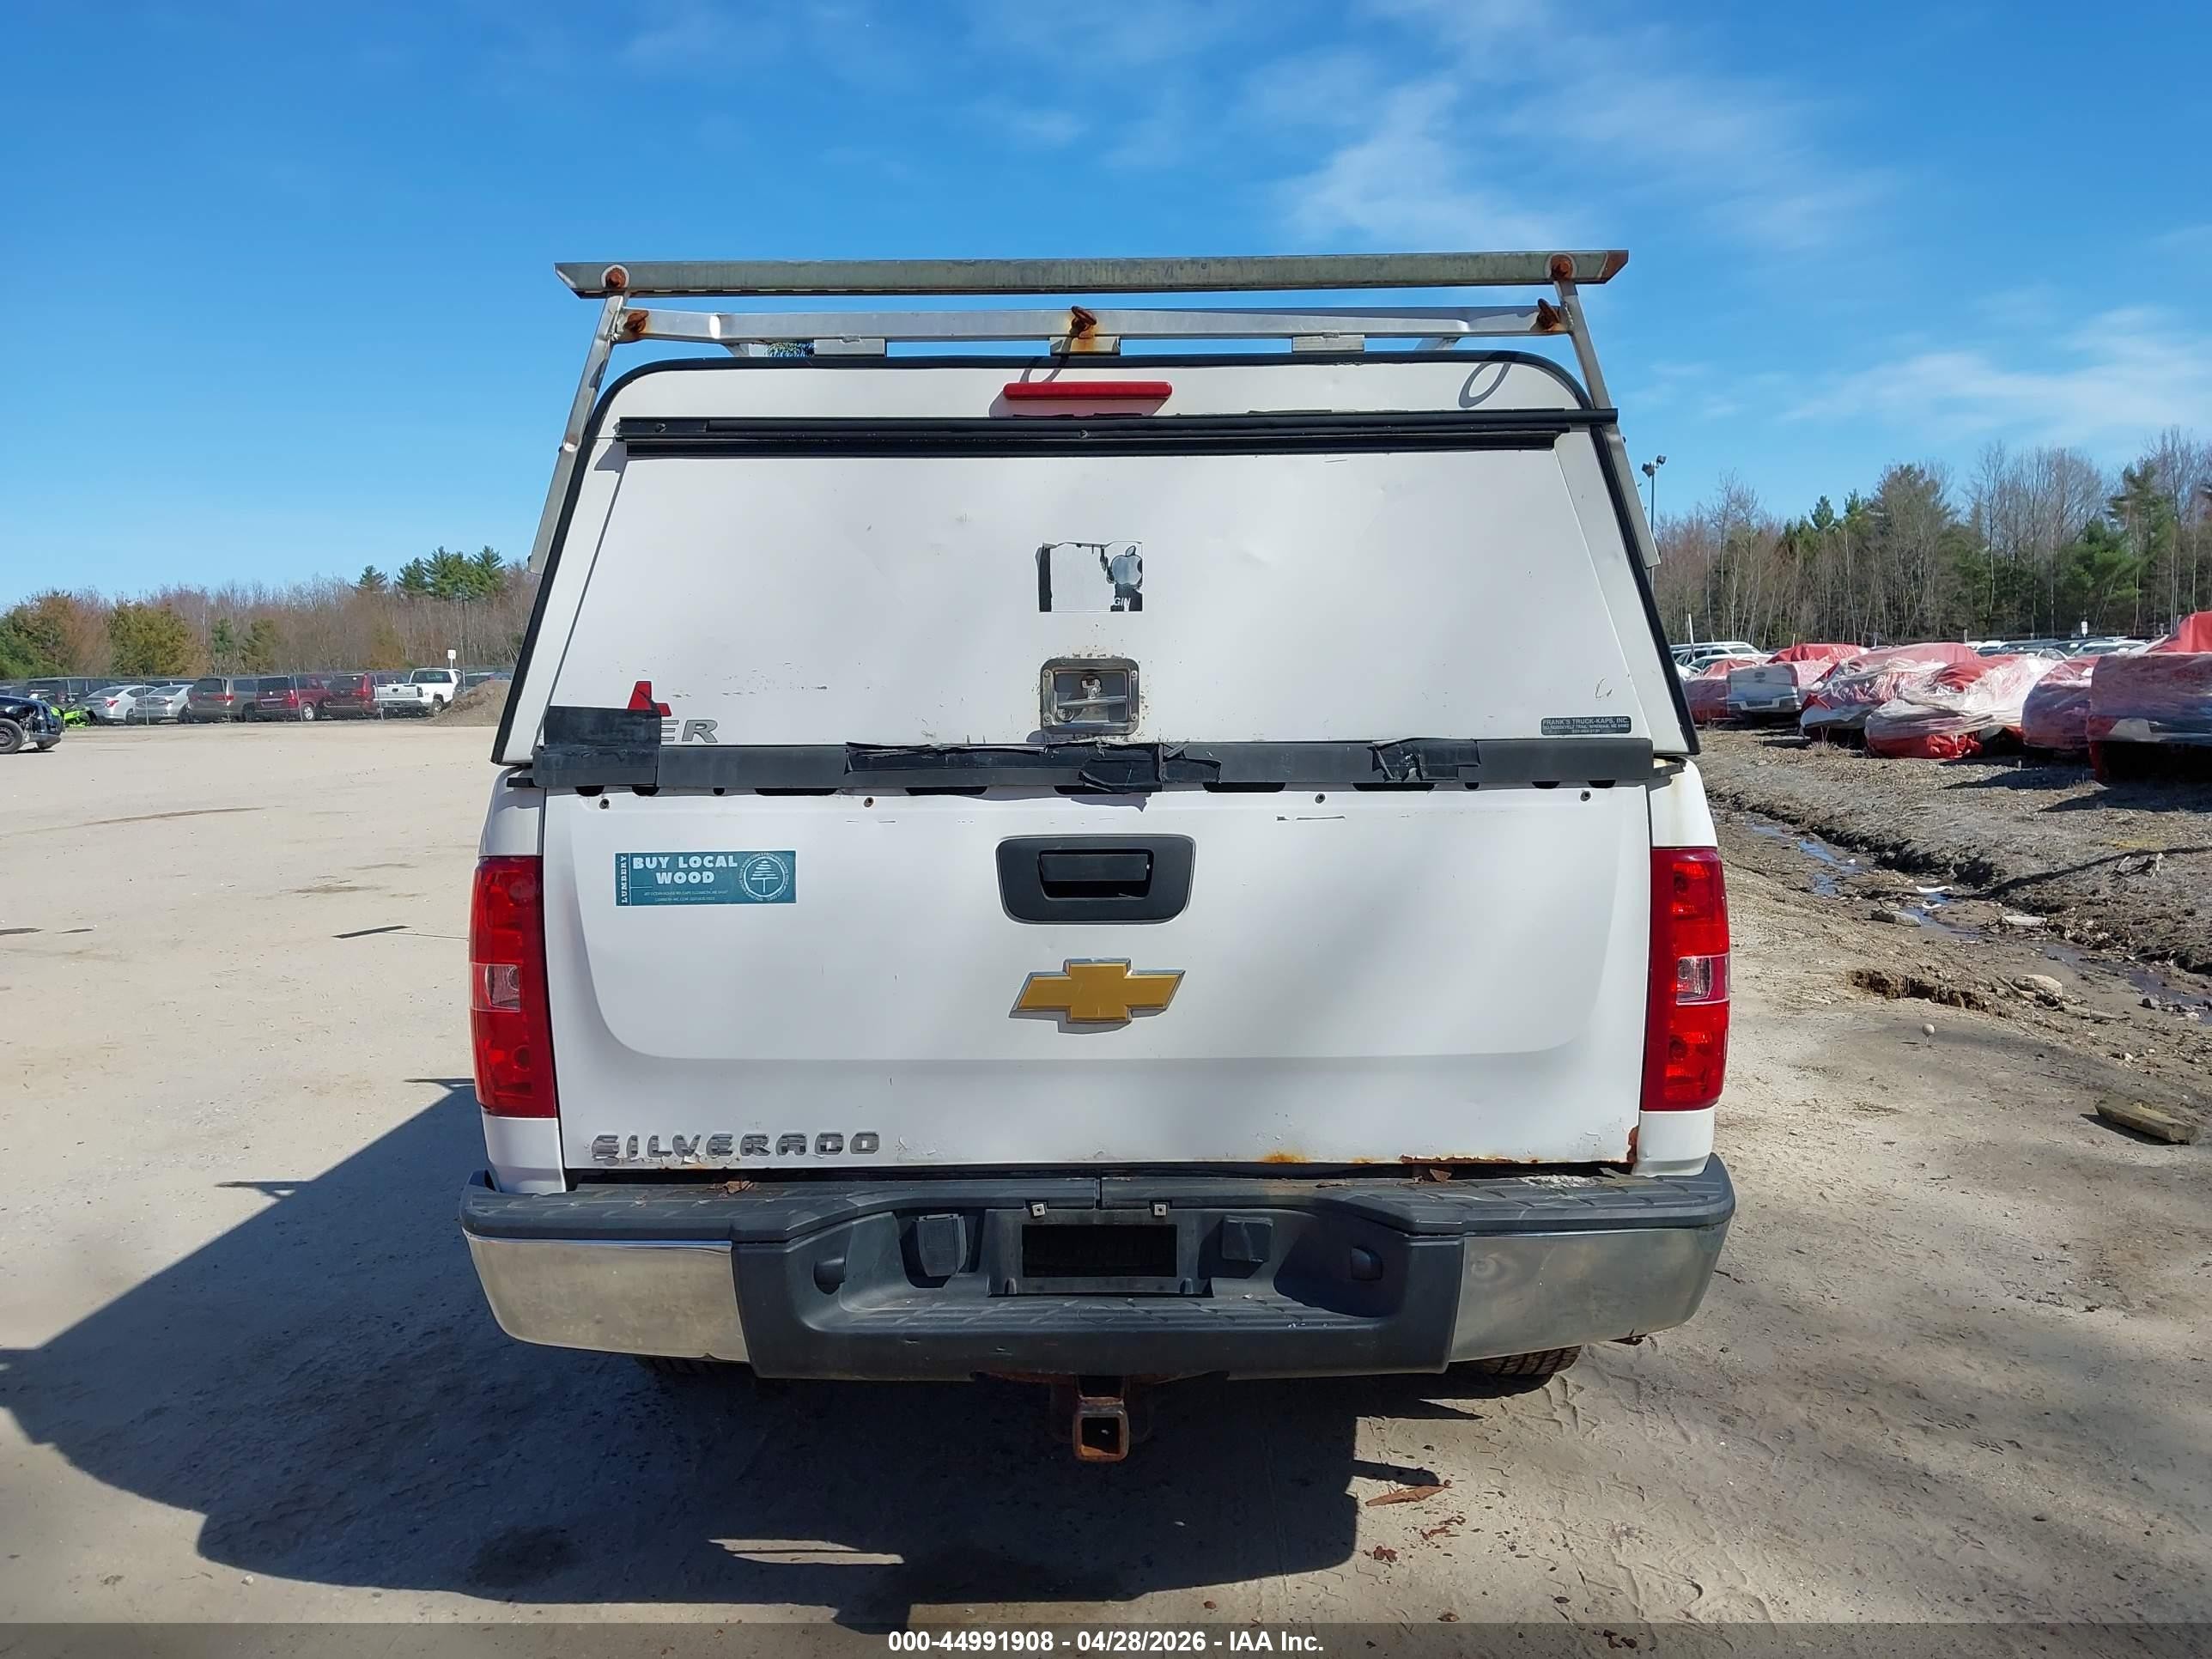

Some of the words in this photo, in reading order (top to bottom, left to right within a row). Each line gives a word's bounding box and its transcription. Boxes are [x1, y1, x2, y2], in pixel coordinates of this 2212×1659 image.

[633, 856, 670, 870] BUY
[678, 855, 738, 869] LOCAL
[656, 872, 715, 884] WOOD
[591, 1133, 880, 1158] SILVERADO
